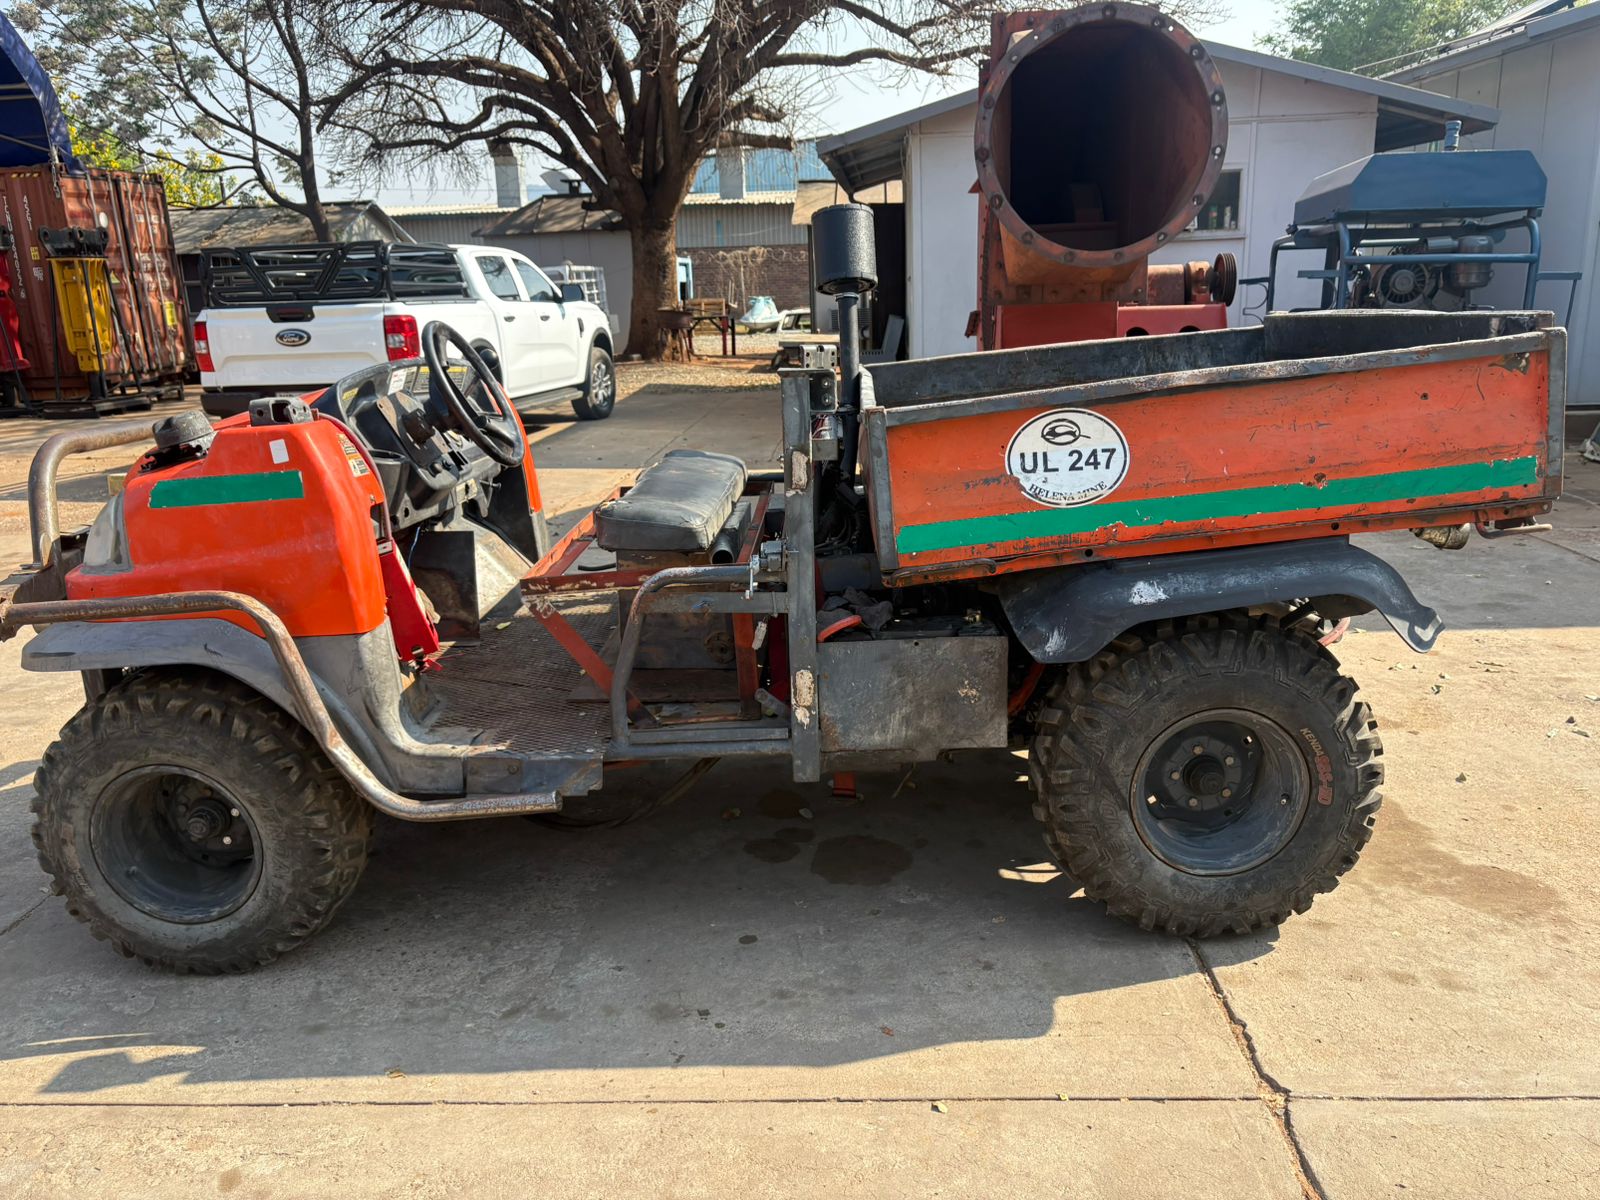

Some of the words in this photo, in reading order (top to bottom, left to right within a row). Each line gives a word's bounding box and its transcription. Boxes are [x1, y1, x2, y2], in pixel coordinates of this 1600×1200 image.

[1019, 451, 1060, 474] UL
[1068, 447, 1117, 472] 247
[1028, 483, 1075, 501] HELENA
[1300, 727, 1325, 756] KENDA
